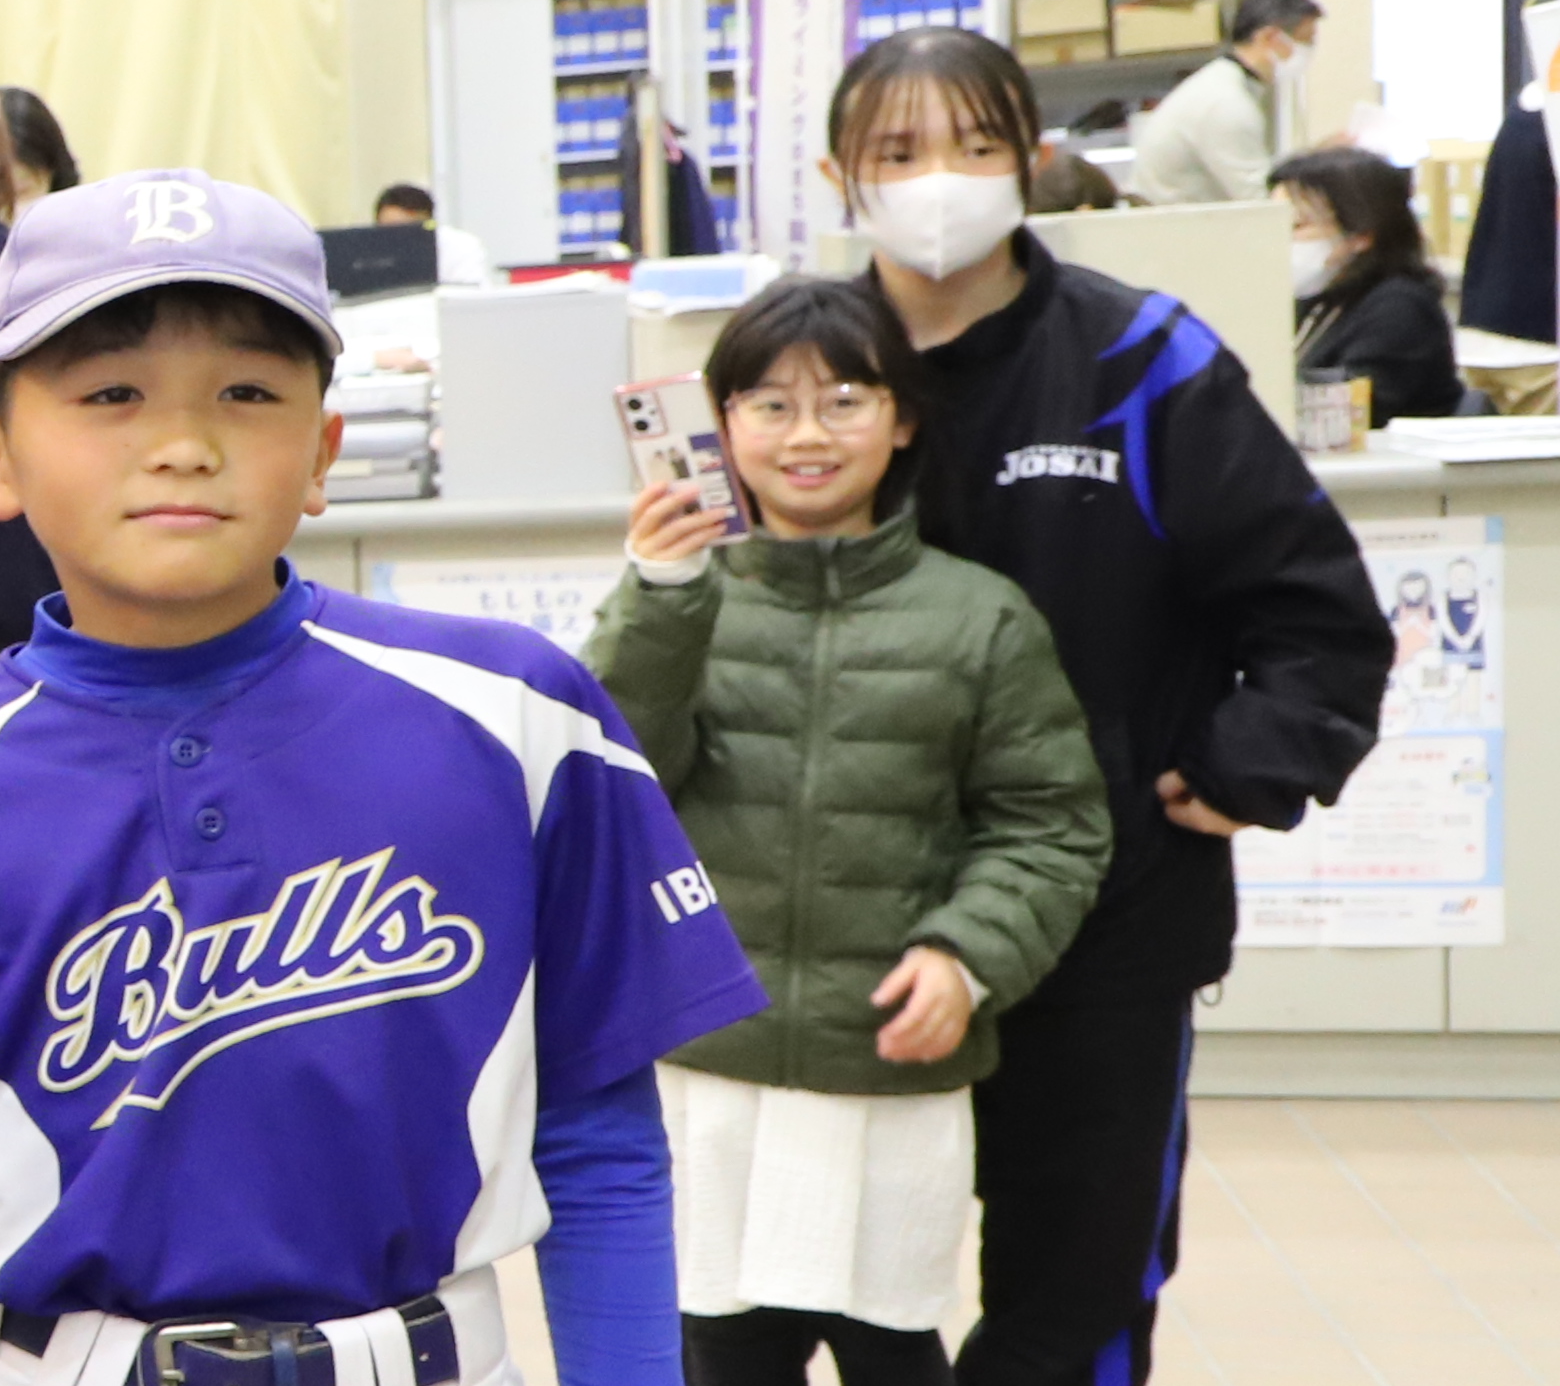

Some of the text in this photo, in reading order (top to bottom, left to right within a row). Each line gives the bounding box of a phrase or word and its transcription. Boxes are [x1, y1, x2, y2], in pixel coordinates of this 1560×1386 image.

[123, 179, 215, 245] B
[995, 449, 1119, 486] JOSAI
[38, 845, 485, 1103] Bulls
